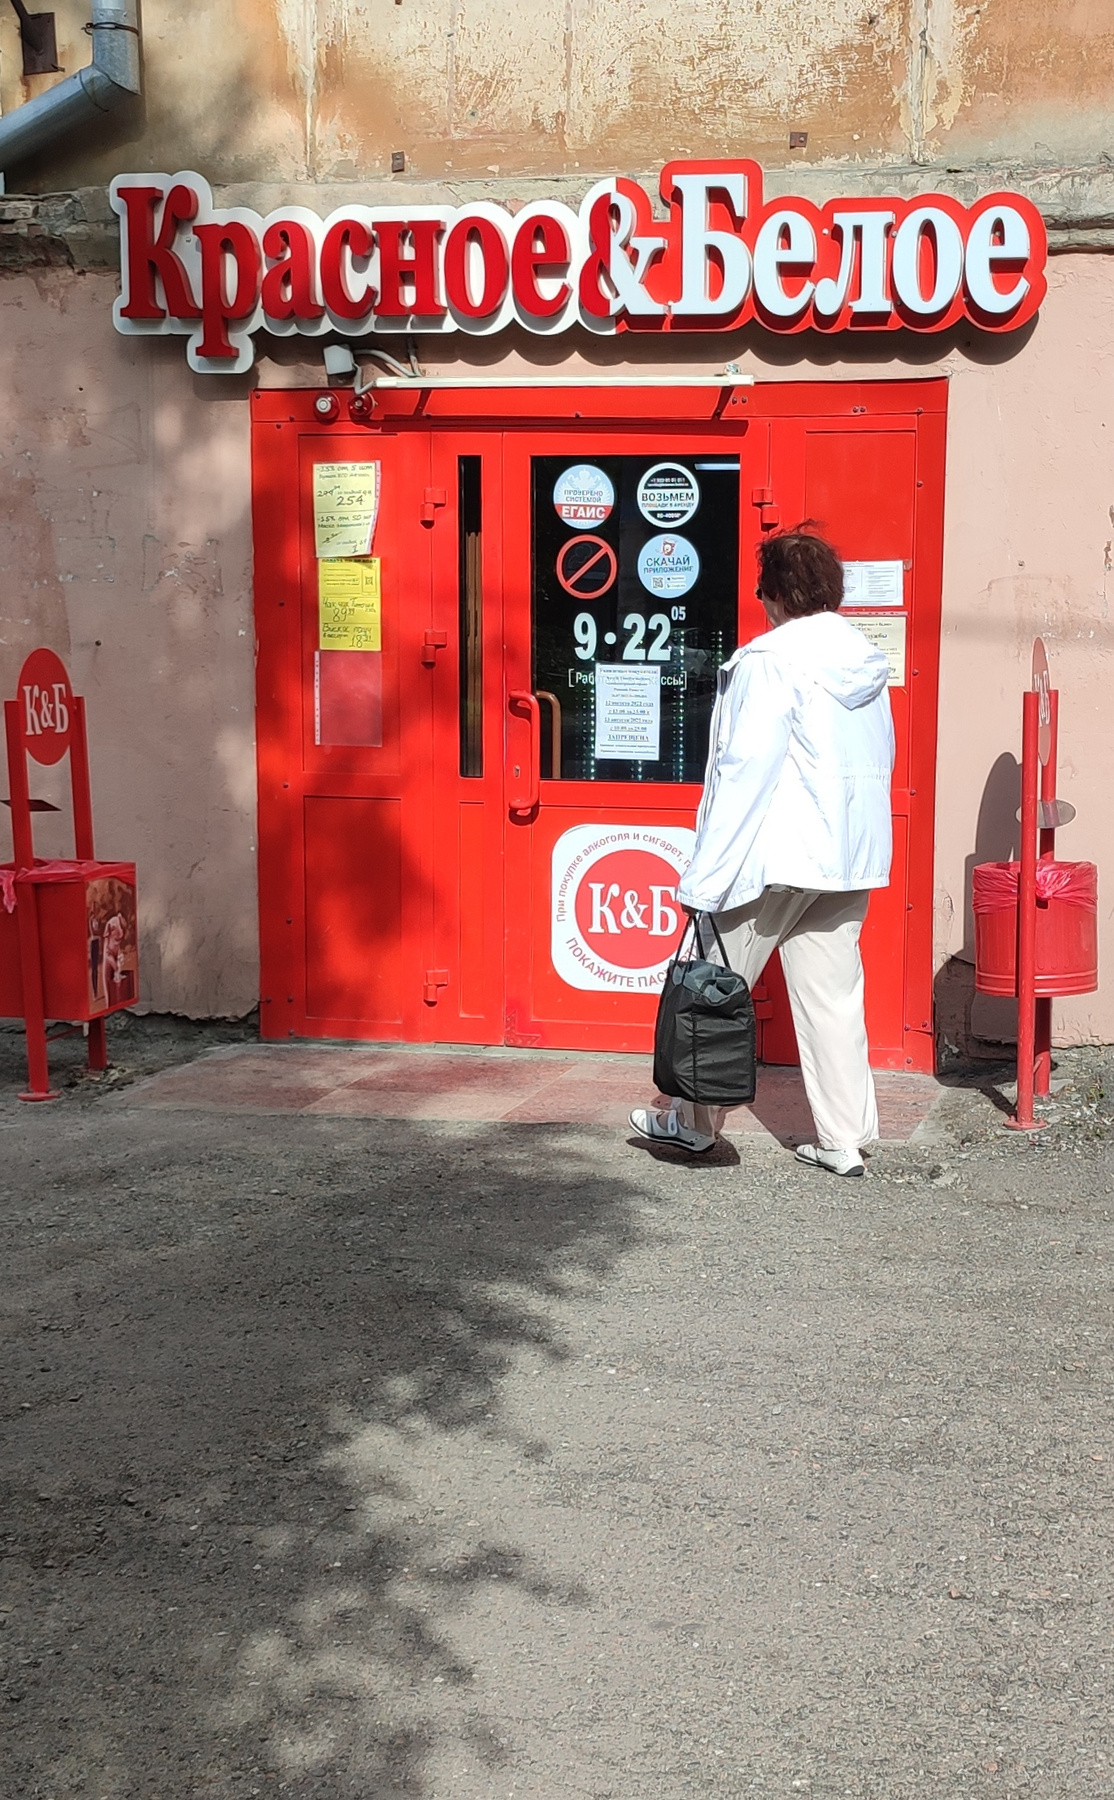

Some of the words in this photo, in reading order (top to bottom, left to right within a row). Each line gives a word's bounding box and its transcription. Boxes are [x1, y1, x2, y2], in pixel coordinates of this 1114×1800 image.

[336, 495, 363, 506] 254
[564, 489, 603, 497] ПРОВЕРЕНО
[641, 492, 694, 502] ВОЗЬМЕМ
[561, 505, 606, 519] ЕГАИС
[646, 555, 690, 567] СКАЧАЙ
[643, 565, 694, 574] ПРИЛОЖЕНИЕ
[670, 606, 686, 621] 05
[22, 683, 69, 736] К&Б
[633, 832, 640, 841] и
[582, 832, 630, 857] алкоголя
[643, 834, 683, 862] сигарет,
[558, 854, 583, 897] покупке
[556, 900, 567, 922] При
[588, 882, 678, 936] К&Б
[566, 937, 635, 987] ПОКАЖИТЕ
